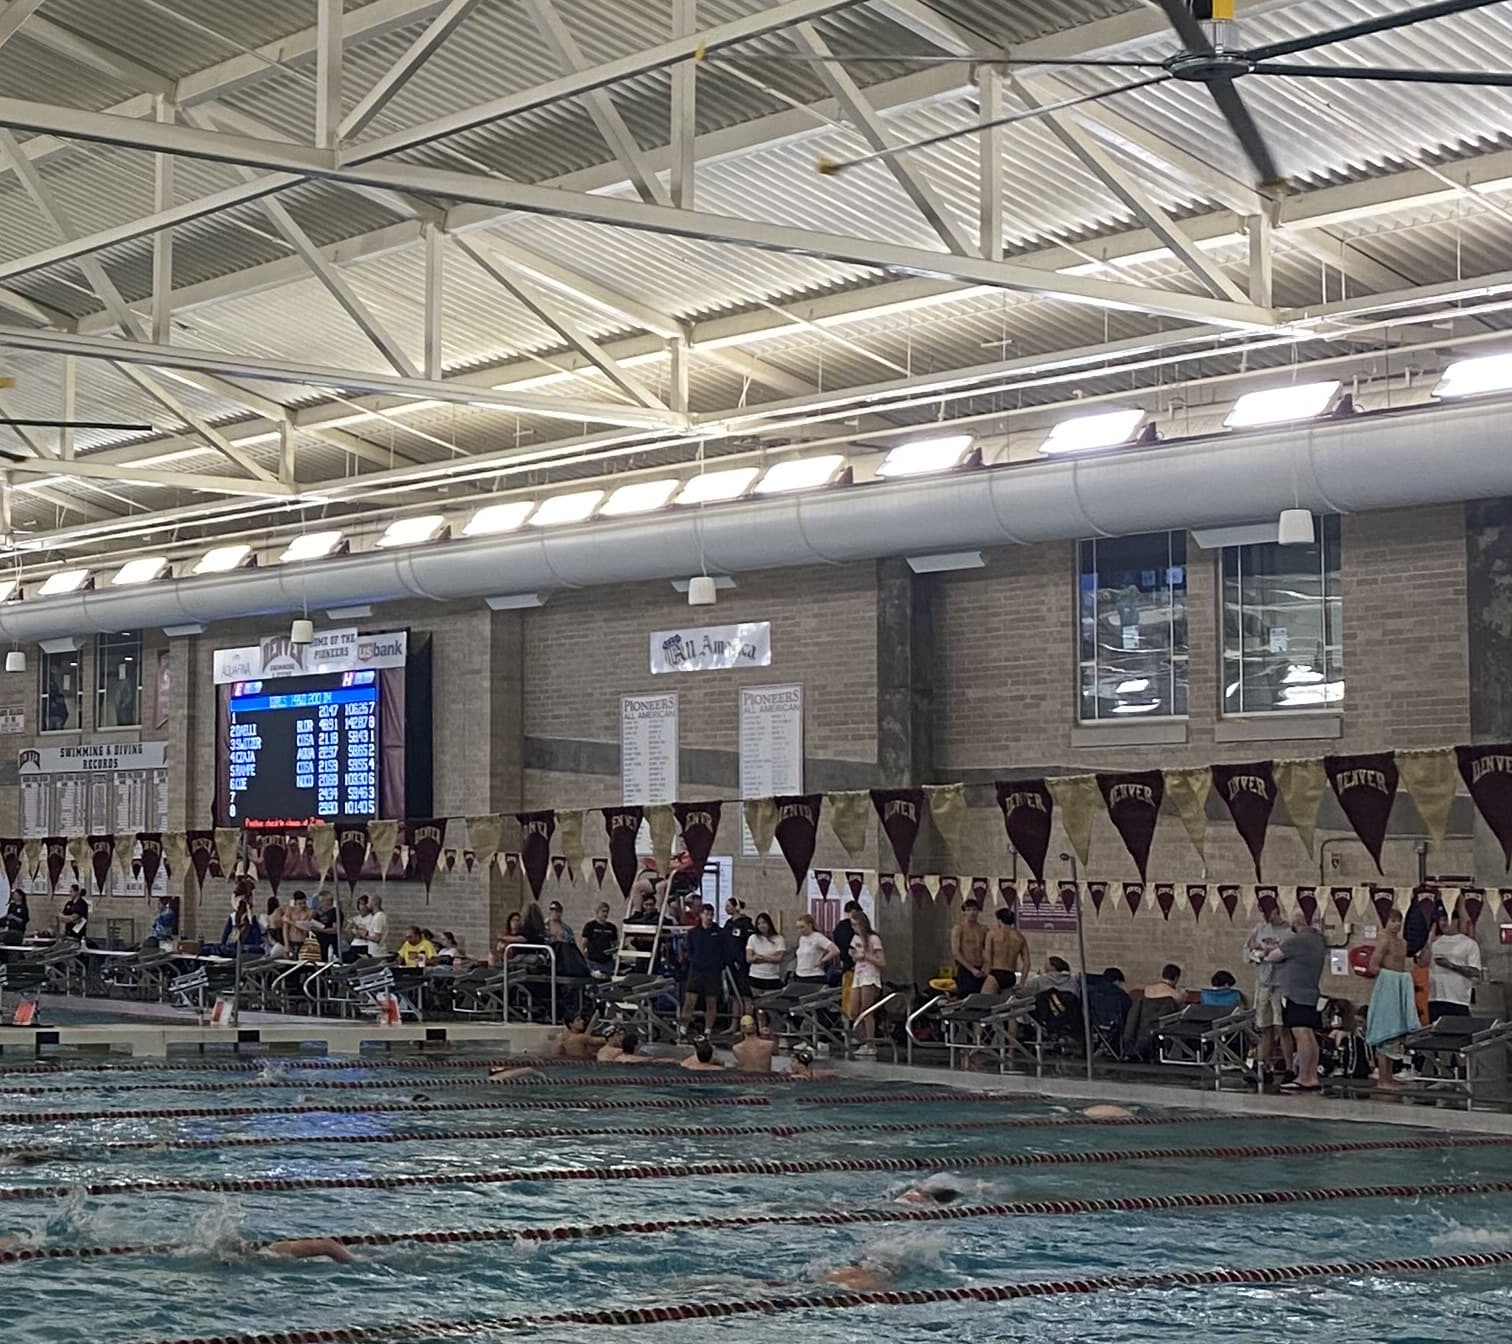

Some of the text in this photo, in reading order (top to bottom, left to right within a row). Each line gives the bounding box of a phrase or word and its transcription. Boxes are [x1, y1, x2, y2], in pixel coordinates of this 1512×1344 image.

[744, 690, 800, 705] PIONEERS
[624, 699, 675, 713] PIONEERS
[760, 704, 800, 713] AMERICAN
[638, 710, 675, 719] AMERICAN
[60, 745, 104, 758] SWIMMING
[114, 744, 143, 756] DIVING
[83, 759, 119, 769] RECORDS
[1472, 755, 1512, 784] DENVE
